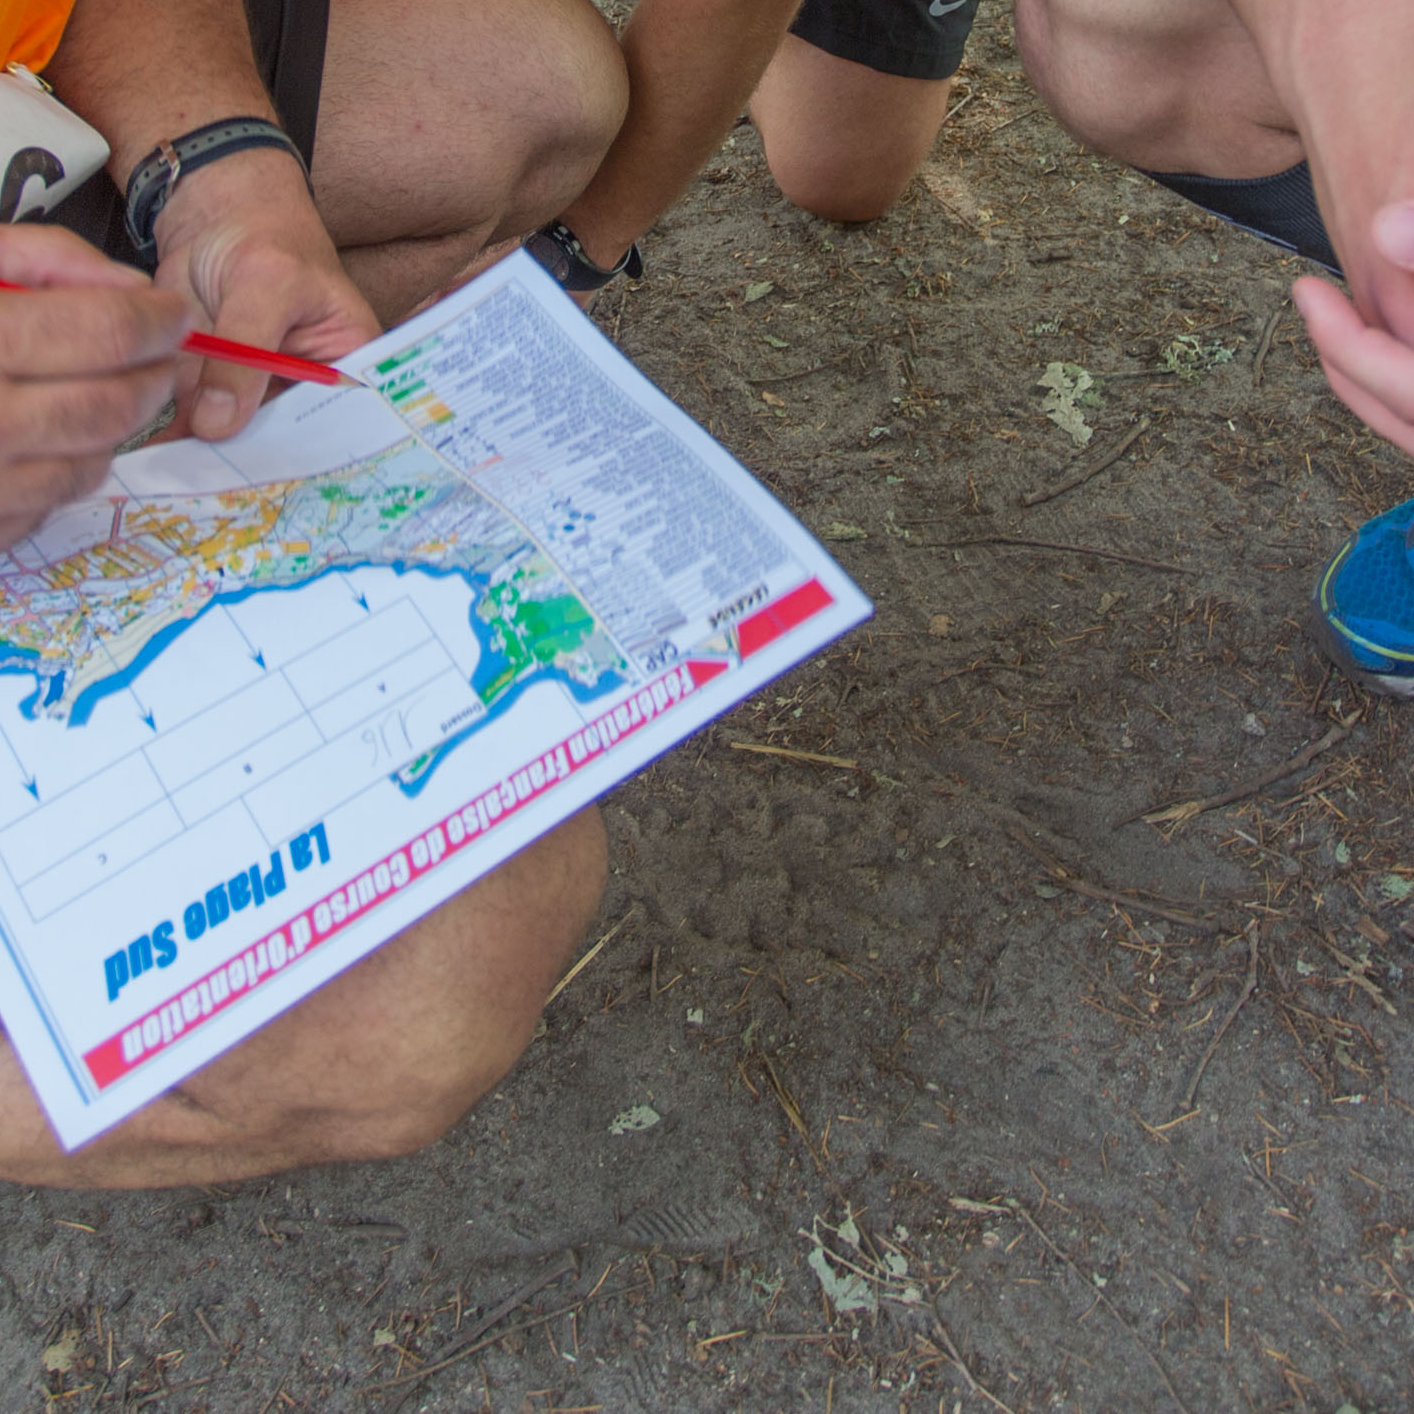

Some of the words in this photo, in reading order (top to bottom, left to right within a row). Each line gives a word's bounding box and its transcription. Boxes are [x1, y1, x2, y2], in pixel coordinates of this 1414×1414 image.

[565, 663, 696, 766] Fédération
[445, 744, 572, 846] Française
[286, 820, 328, 873] La
[412, 826, 448, 864] de
[178, 848, 286, 944] Plage
[310, 850, 411, 934] Course
[102, 918, 180, 1003] Sud
[118, 915, 310, 1065] d'Orientation
